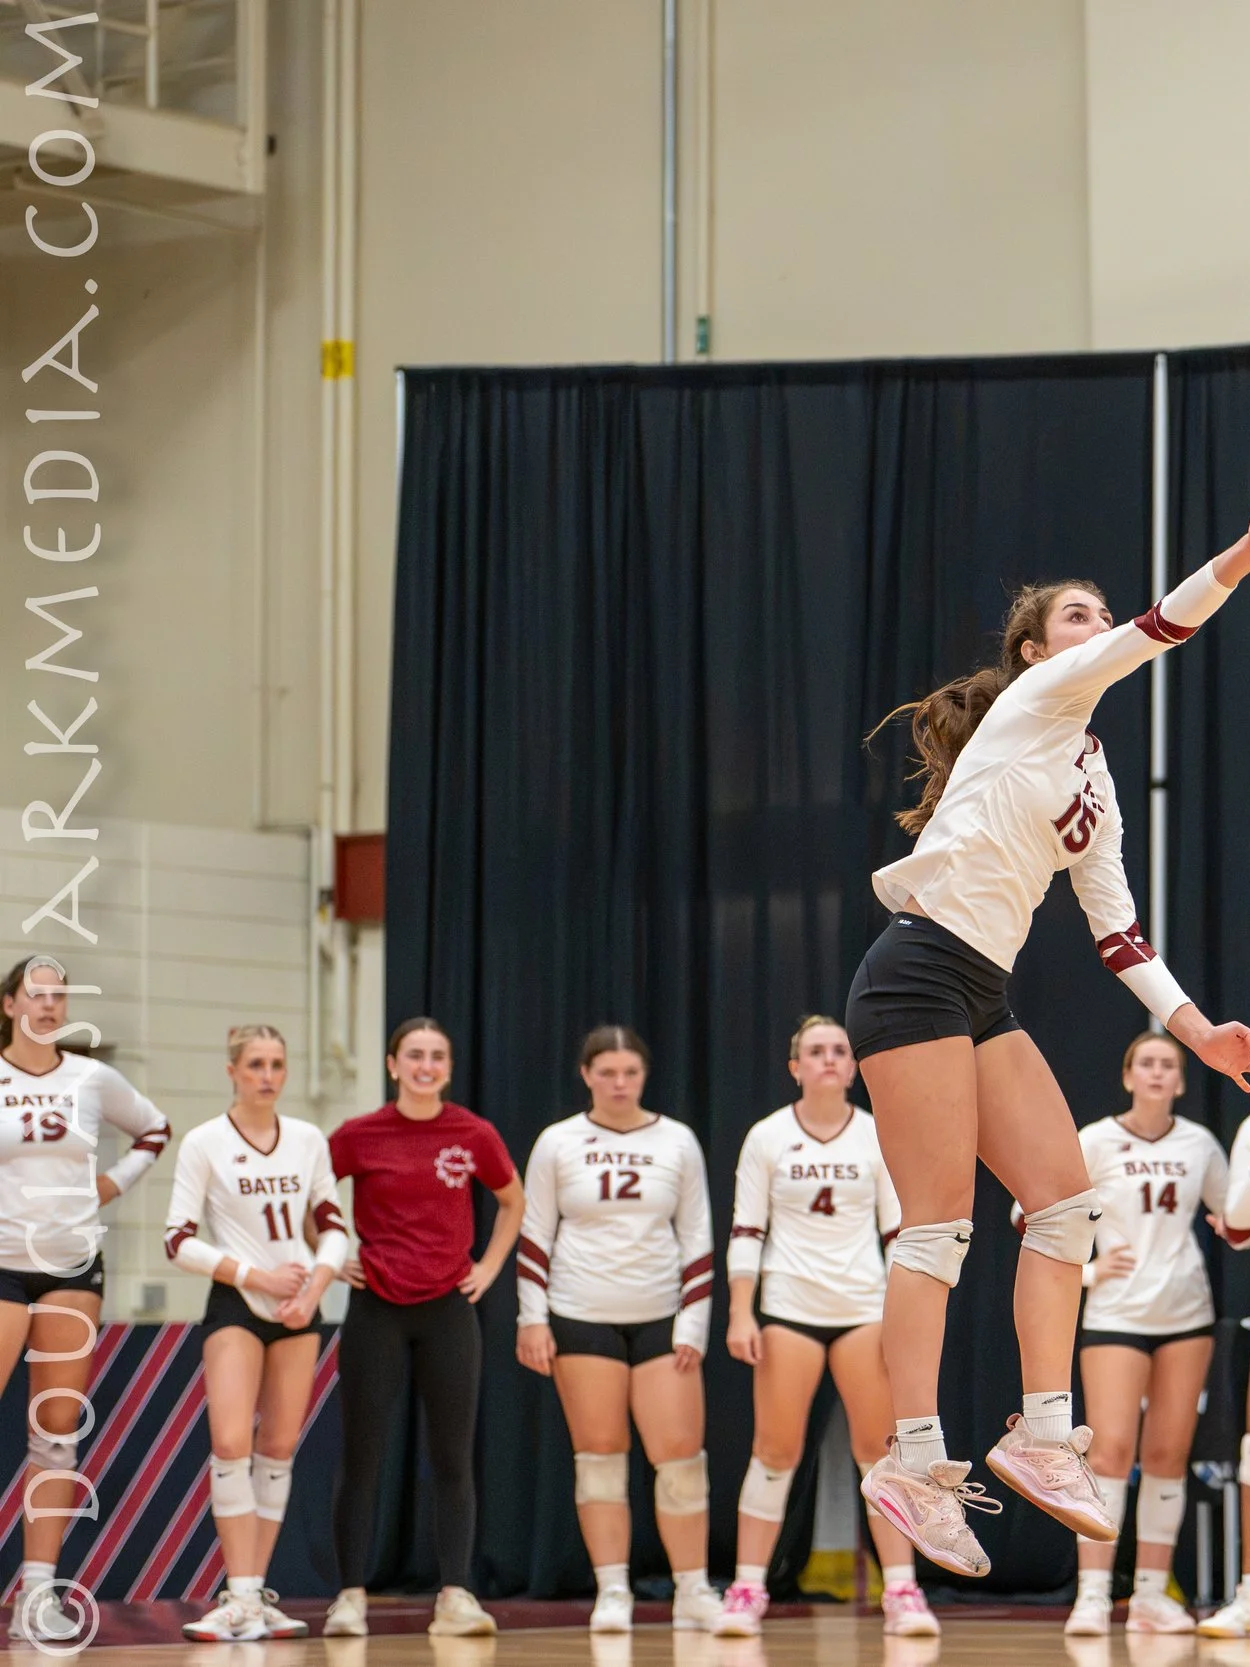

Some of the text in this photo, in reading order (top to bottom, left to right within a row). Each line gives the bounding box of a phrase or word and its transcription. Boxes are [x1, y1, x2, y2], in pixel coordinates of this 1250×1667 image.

[1050, 791, 1097, 854] 15
[21, 1111, 68, 1142] 19
[585, 1150, 654, 1166] BATES
[791, 1163, 859, 1180] BATES
[1124, 1161, 1187, 1177] BATES
[238, 1175, 301, 1195] BATES
[598, 1169, 642, 1201] 12
[1140, 1181, 1178, 1215] 14
[810, 1186, 835, 1216] 4
[261, 1202, 294, 1242] 11
